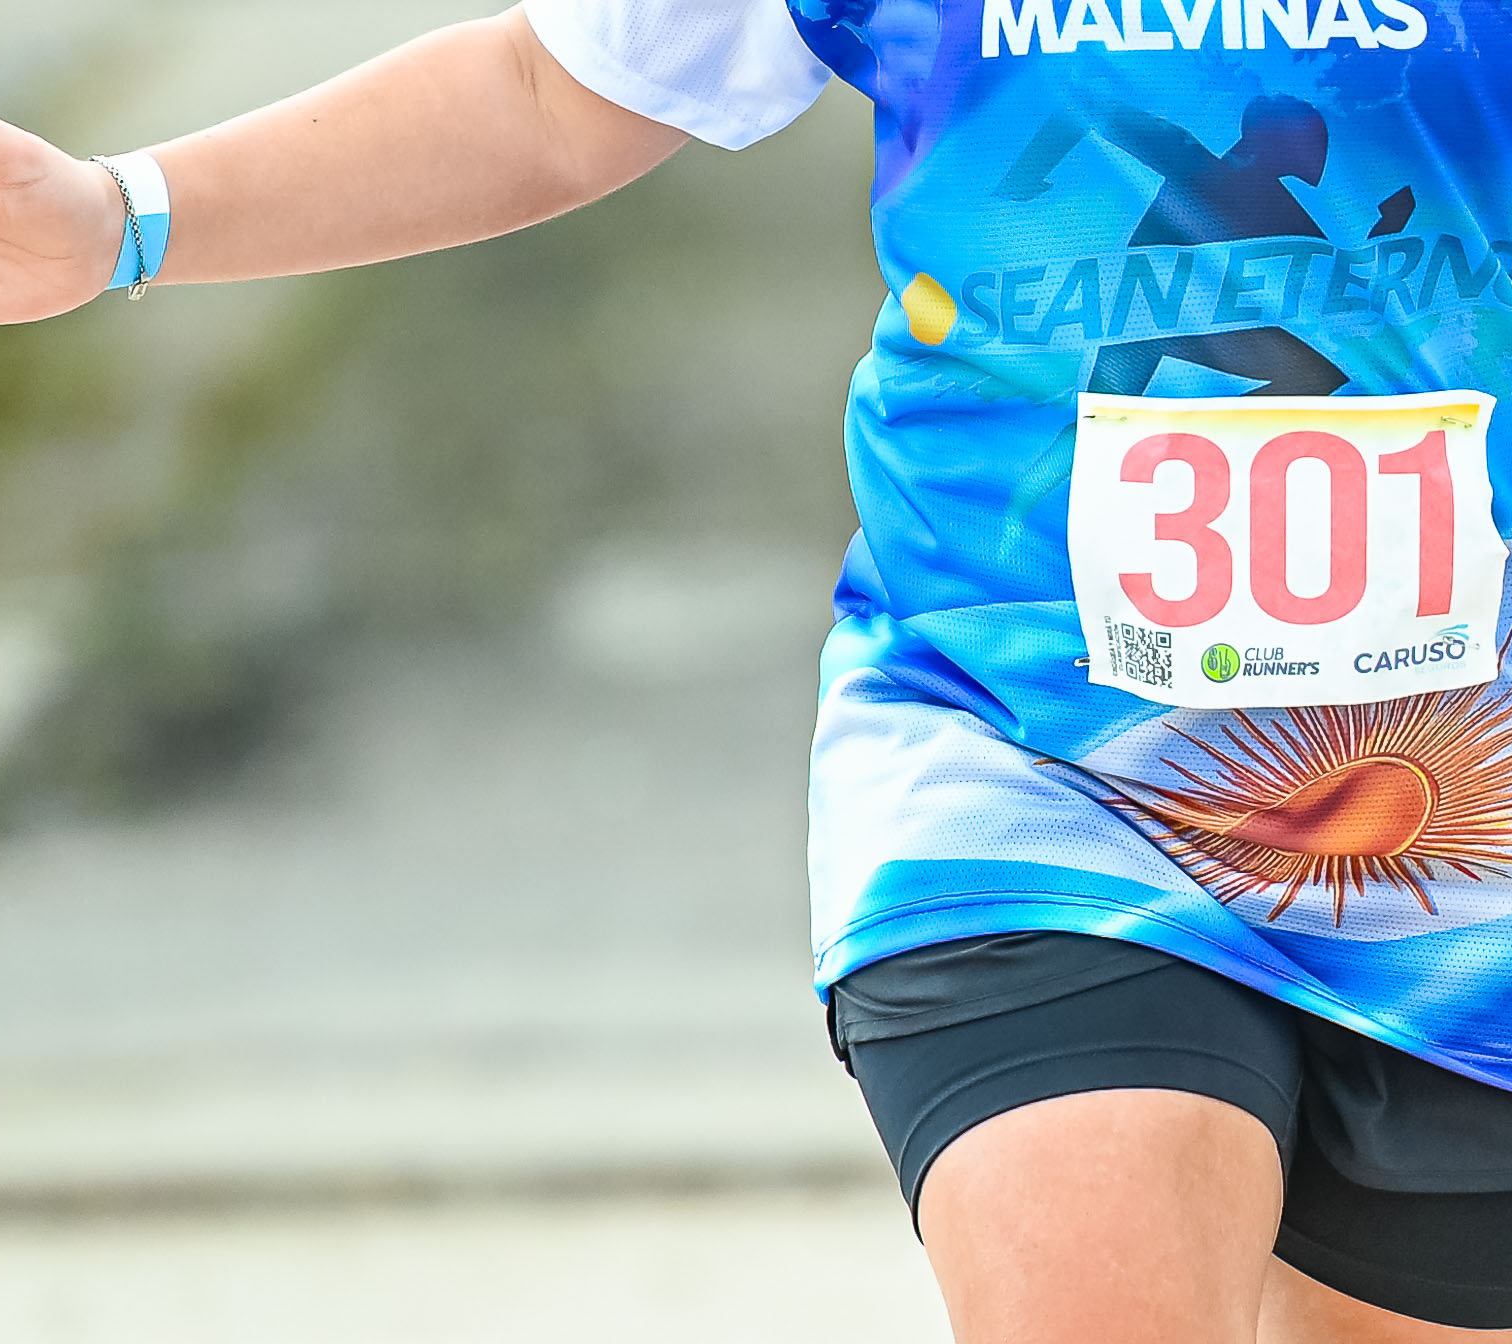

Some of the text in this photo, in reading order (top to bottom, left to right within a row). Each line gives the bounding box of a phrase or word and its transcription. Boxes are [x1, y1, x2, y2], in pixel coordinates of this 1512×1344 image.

[958, 250, 1195, 347] SEAN
[1118, 430, 1455, 628] 301
[1242, 661, 1320, 676] RUNNER'S
[1244, 647, 1284, 661] CLUB
[1353, 639, 1466, 674] CARUSO
